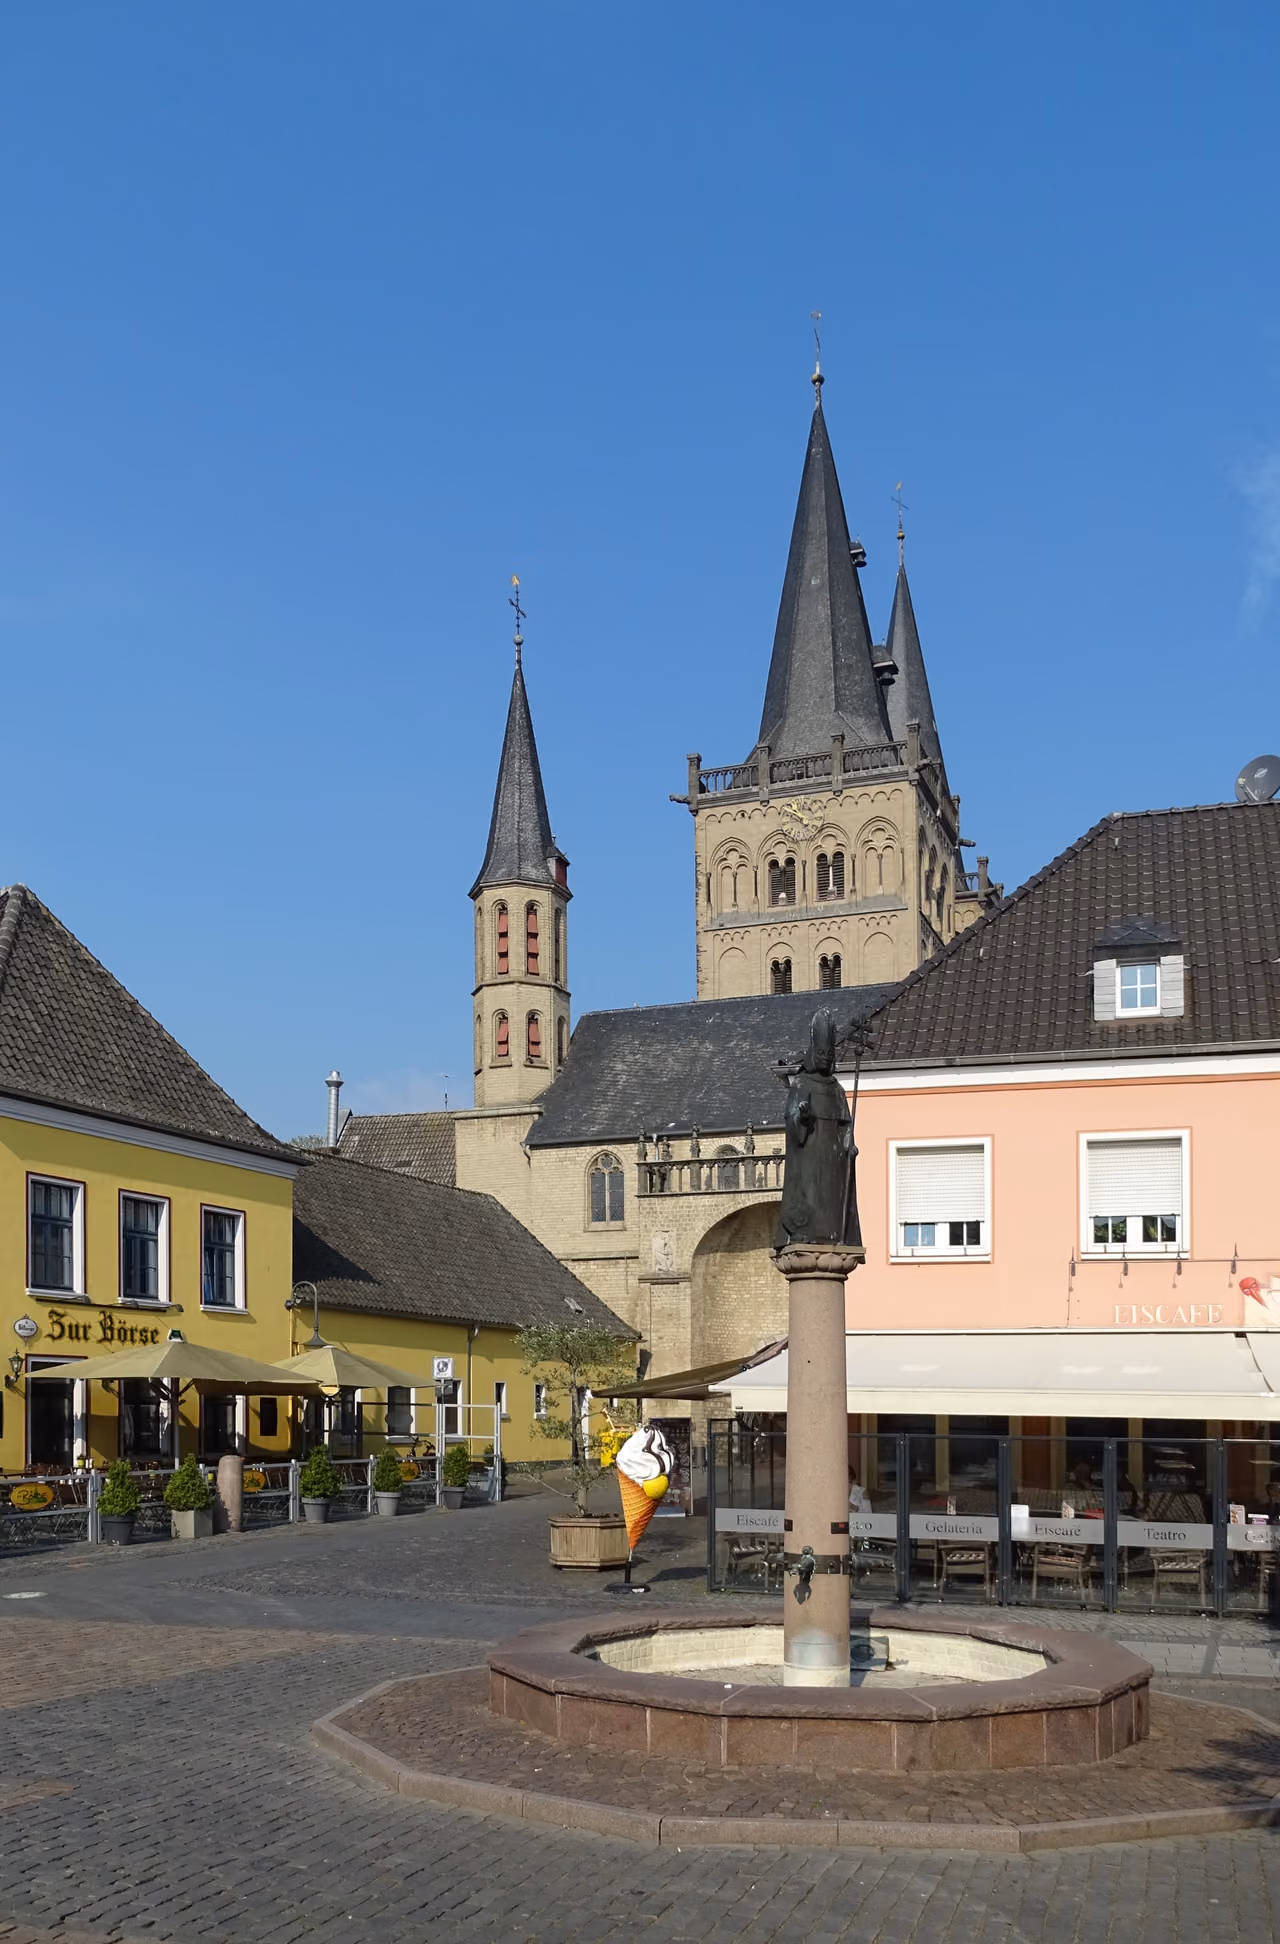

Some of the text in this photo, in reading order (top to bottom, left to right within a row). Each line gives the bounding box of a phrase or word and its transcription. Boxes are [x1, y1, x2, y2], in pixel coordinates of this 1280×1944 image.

[44, 1309, 160, 1346] Zur Börse
[735, 1514, 780, 1527] Eiscafé
[925, 1521, 983, 1535] Gelateria
[1034, 1523, 1082, 1537] Eiscafé
[1143, 1527, 1187, 1541] Teatro
